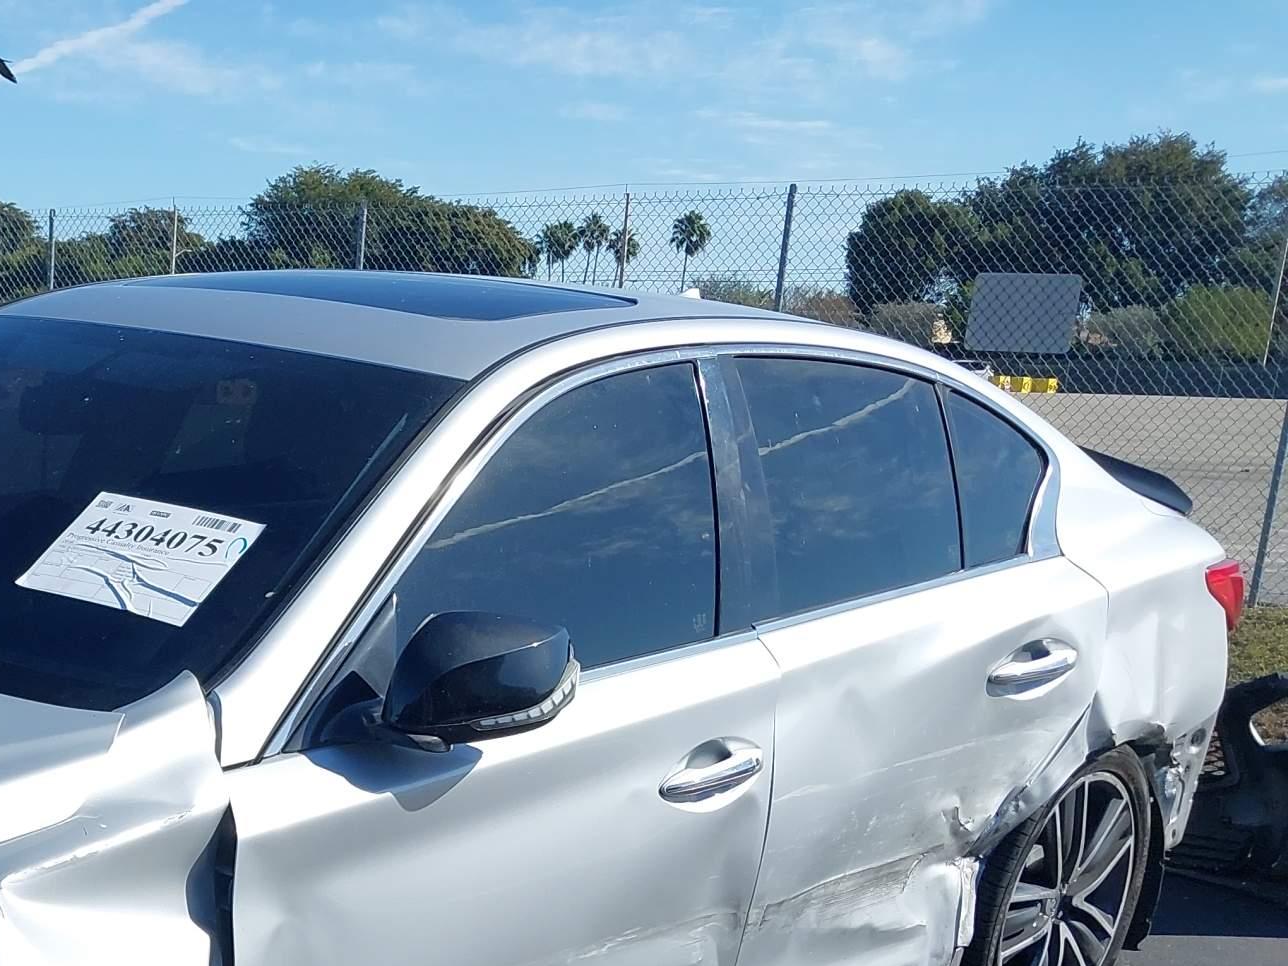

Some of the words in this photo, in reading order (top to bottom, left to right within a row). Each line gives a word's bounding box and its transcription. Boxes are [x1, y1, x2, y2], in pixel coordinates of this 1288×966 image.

[86, 517, 224, 557] 44304075
[106, 538, 135, 550] Casualty
[136, 544, 171, 556] Insurance
